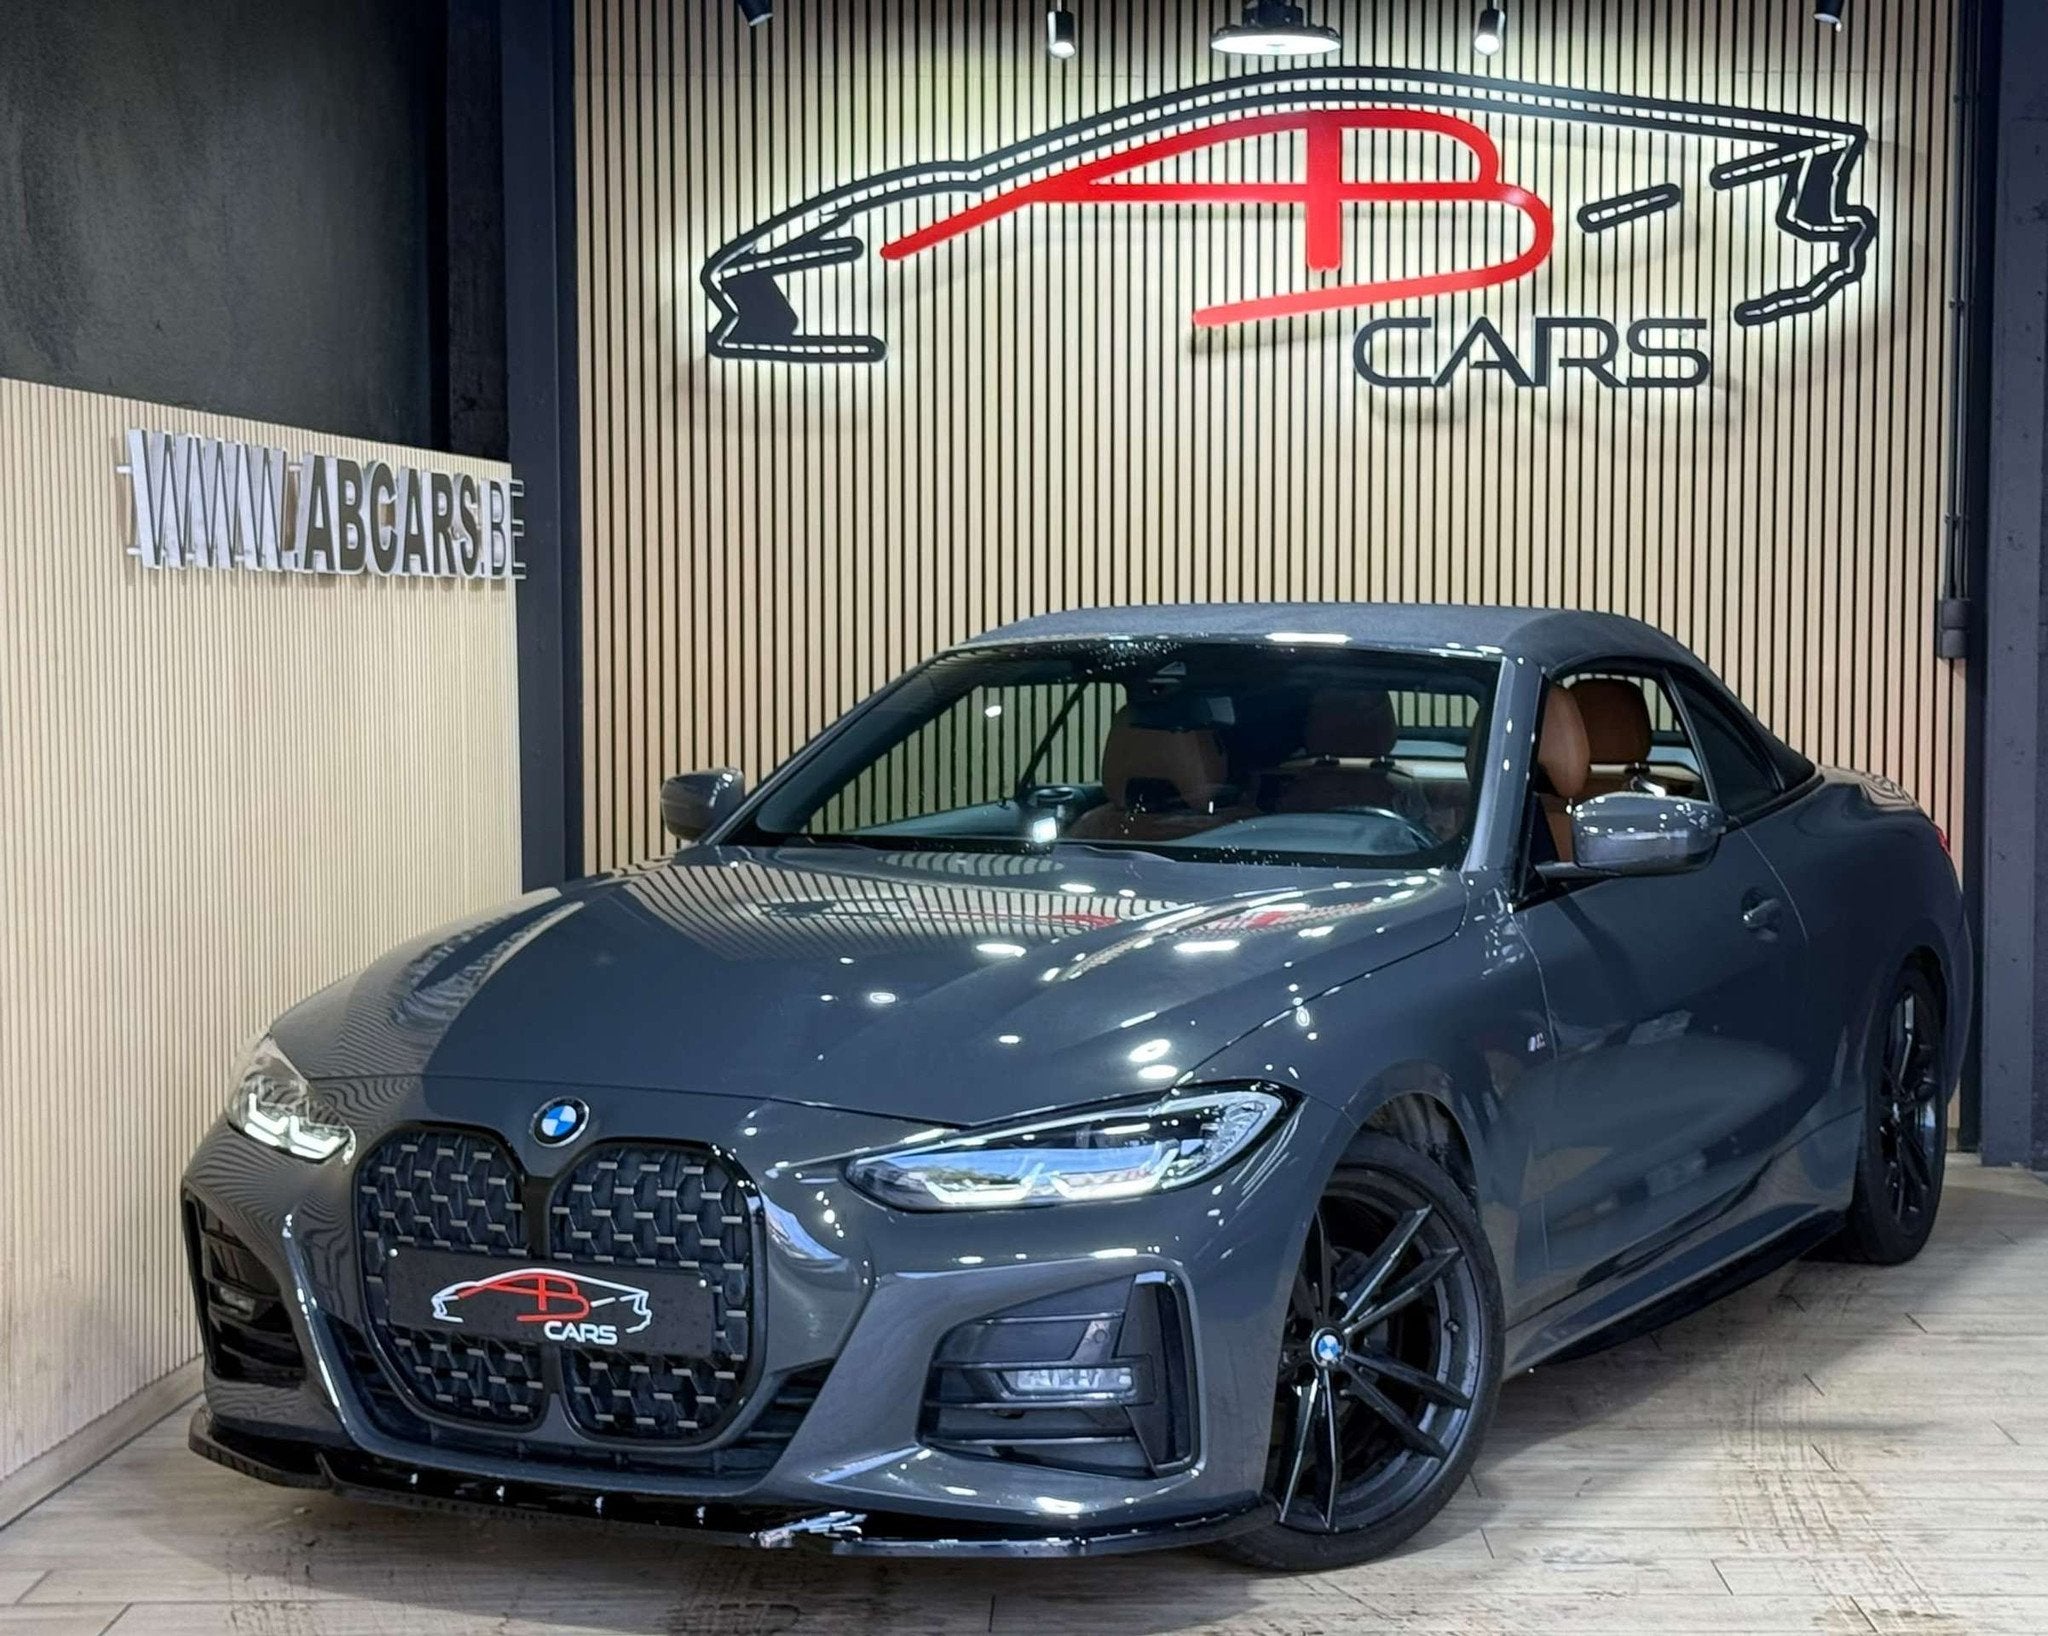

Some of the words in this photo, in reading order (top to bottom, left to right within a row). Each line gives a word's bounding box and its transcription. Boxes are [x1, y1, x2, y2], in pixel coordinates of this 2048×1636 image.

[1353, 317, 1711, 388] CARS
[128, 429, 526, 580] WWW.ABCARS.BE
[544, 1320, 618, 1345] CARS
